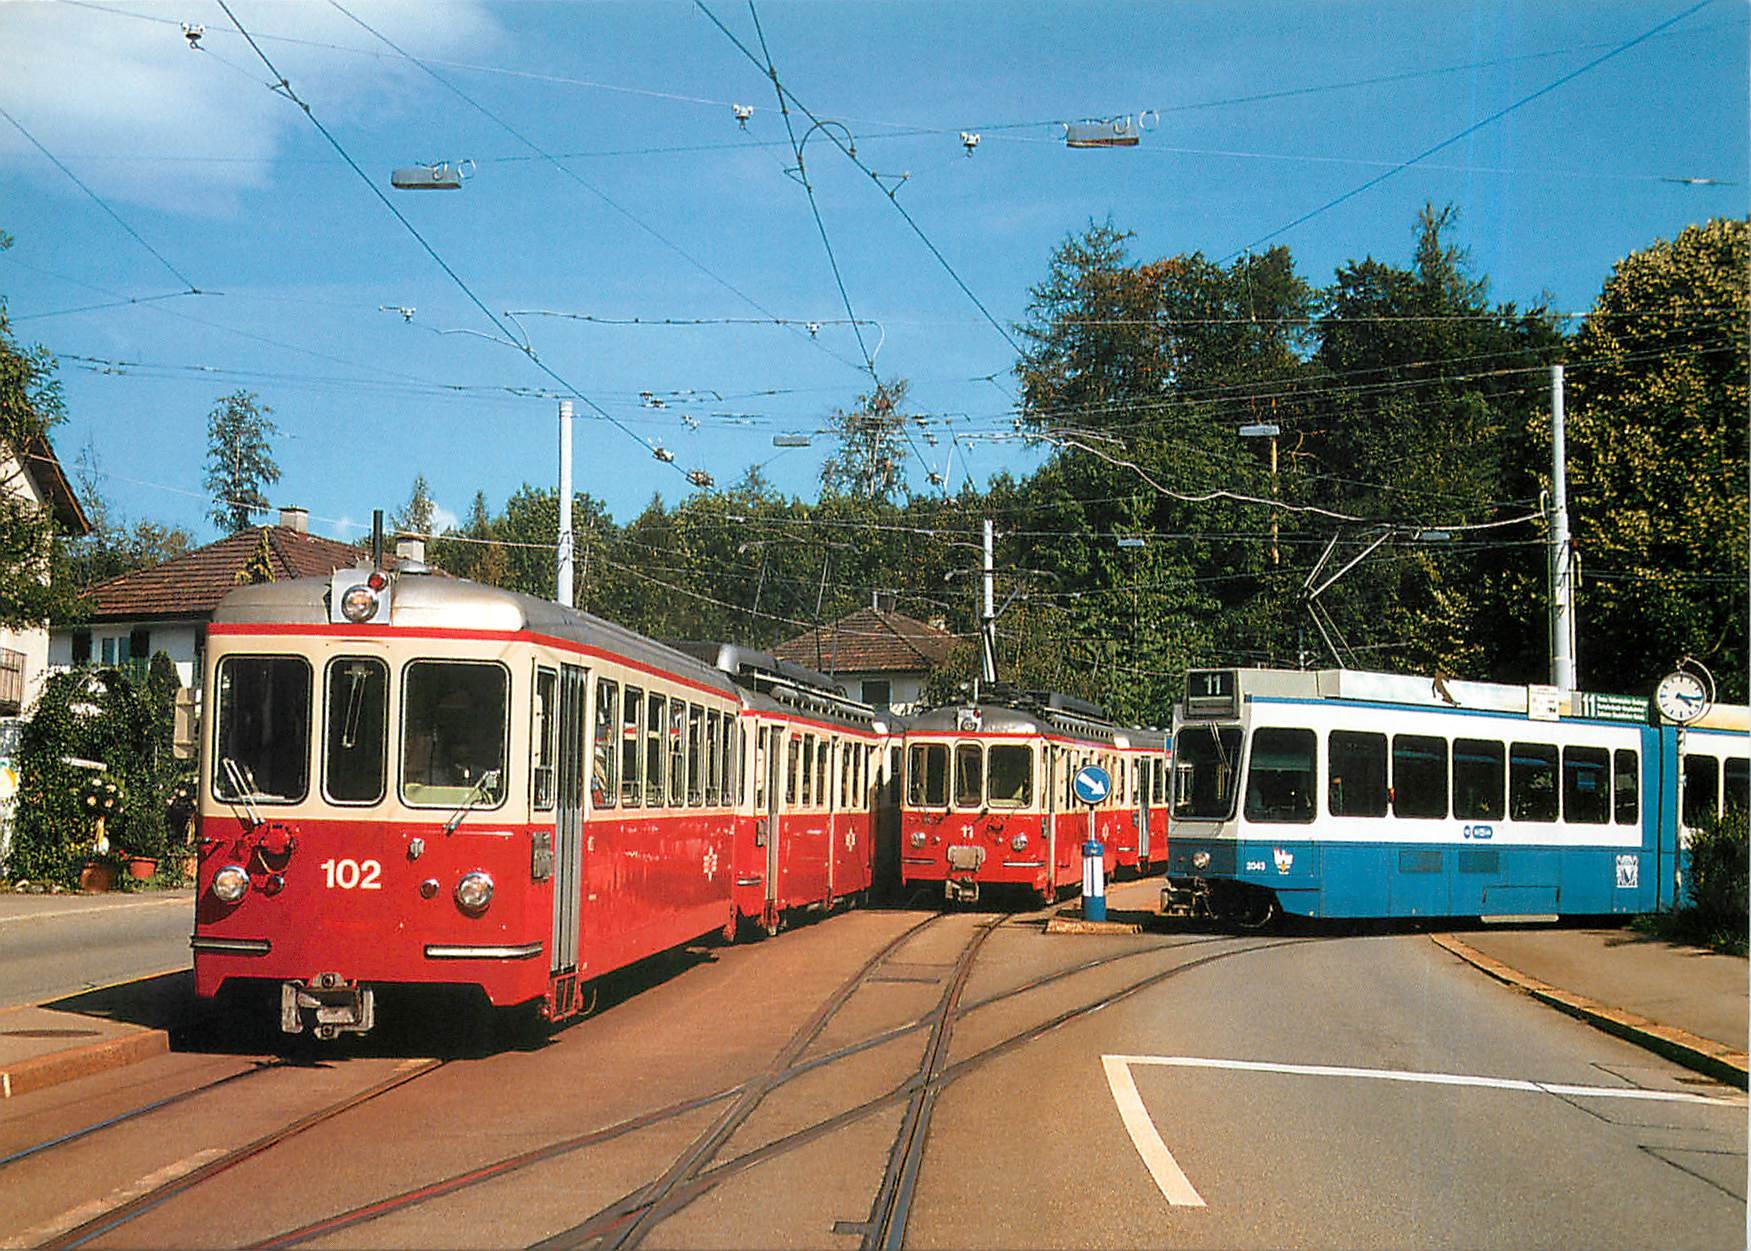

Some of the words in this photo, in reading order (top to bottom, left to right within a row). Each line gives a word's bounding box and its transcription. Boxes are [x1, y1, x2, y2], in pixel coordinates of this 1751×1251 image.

[1203, 674, 1221, 695] 11
[1582, 693, 1596, 718] 11
[960, 824, 974, 839] 11
[320, 858, 382, 890] 102
